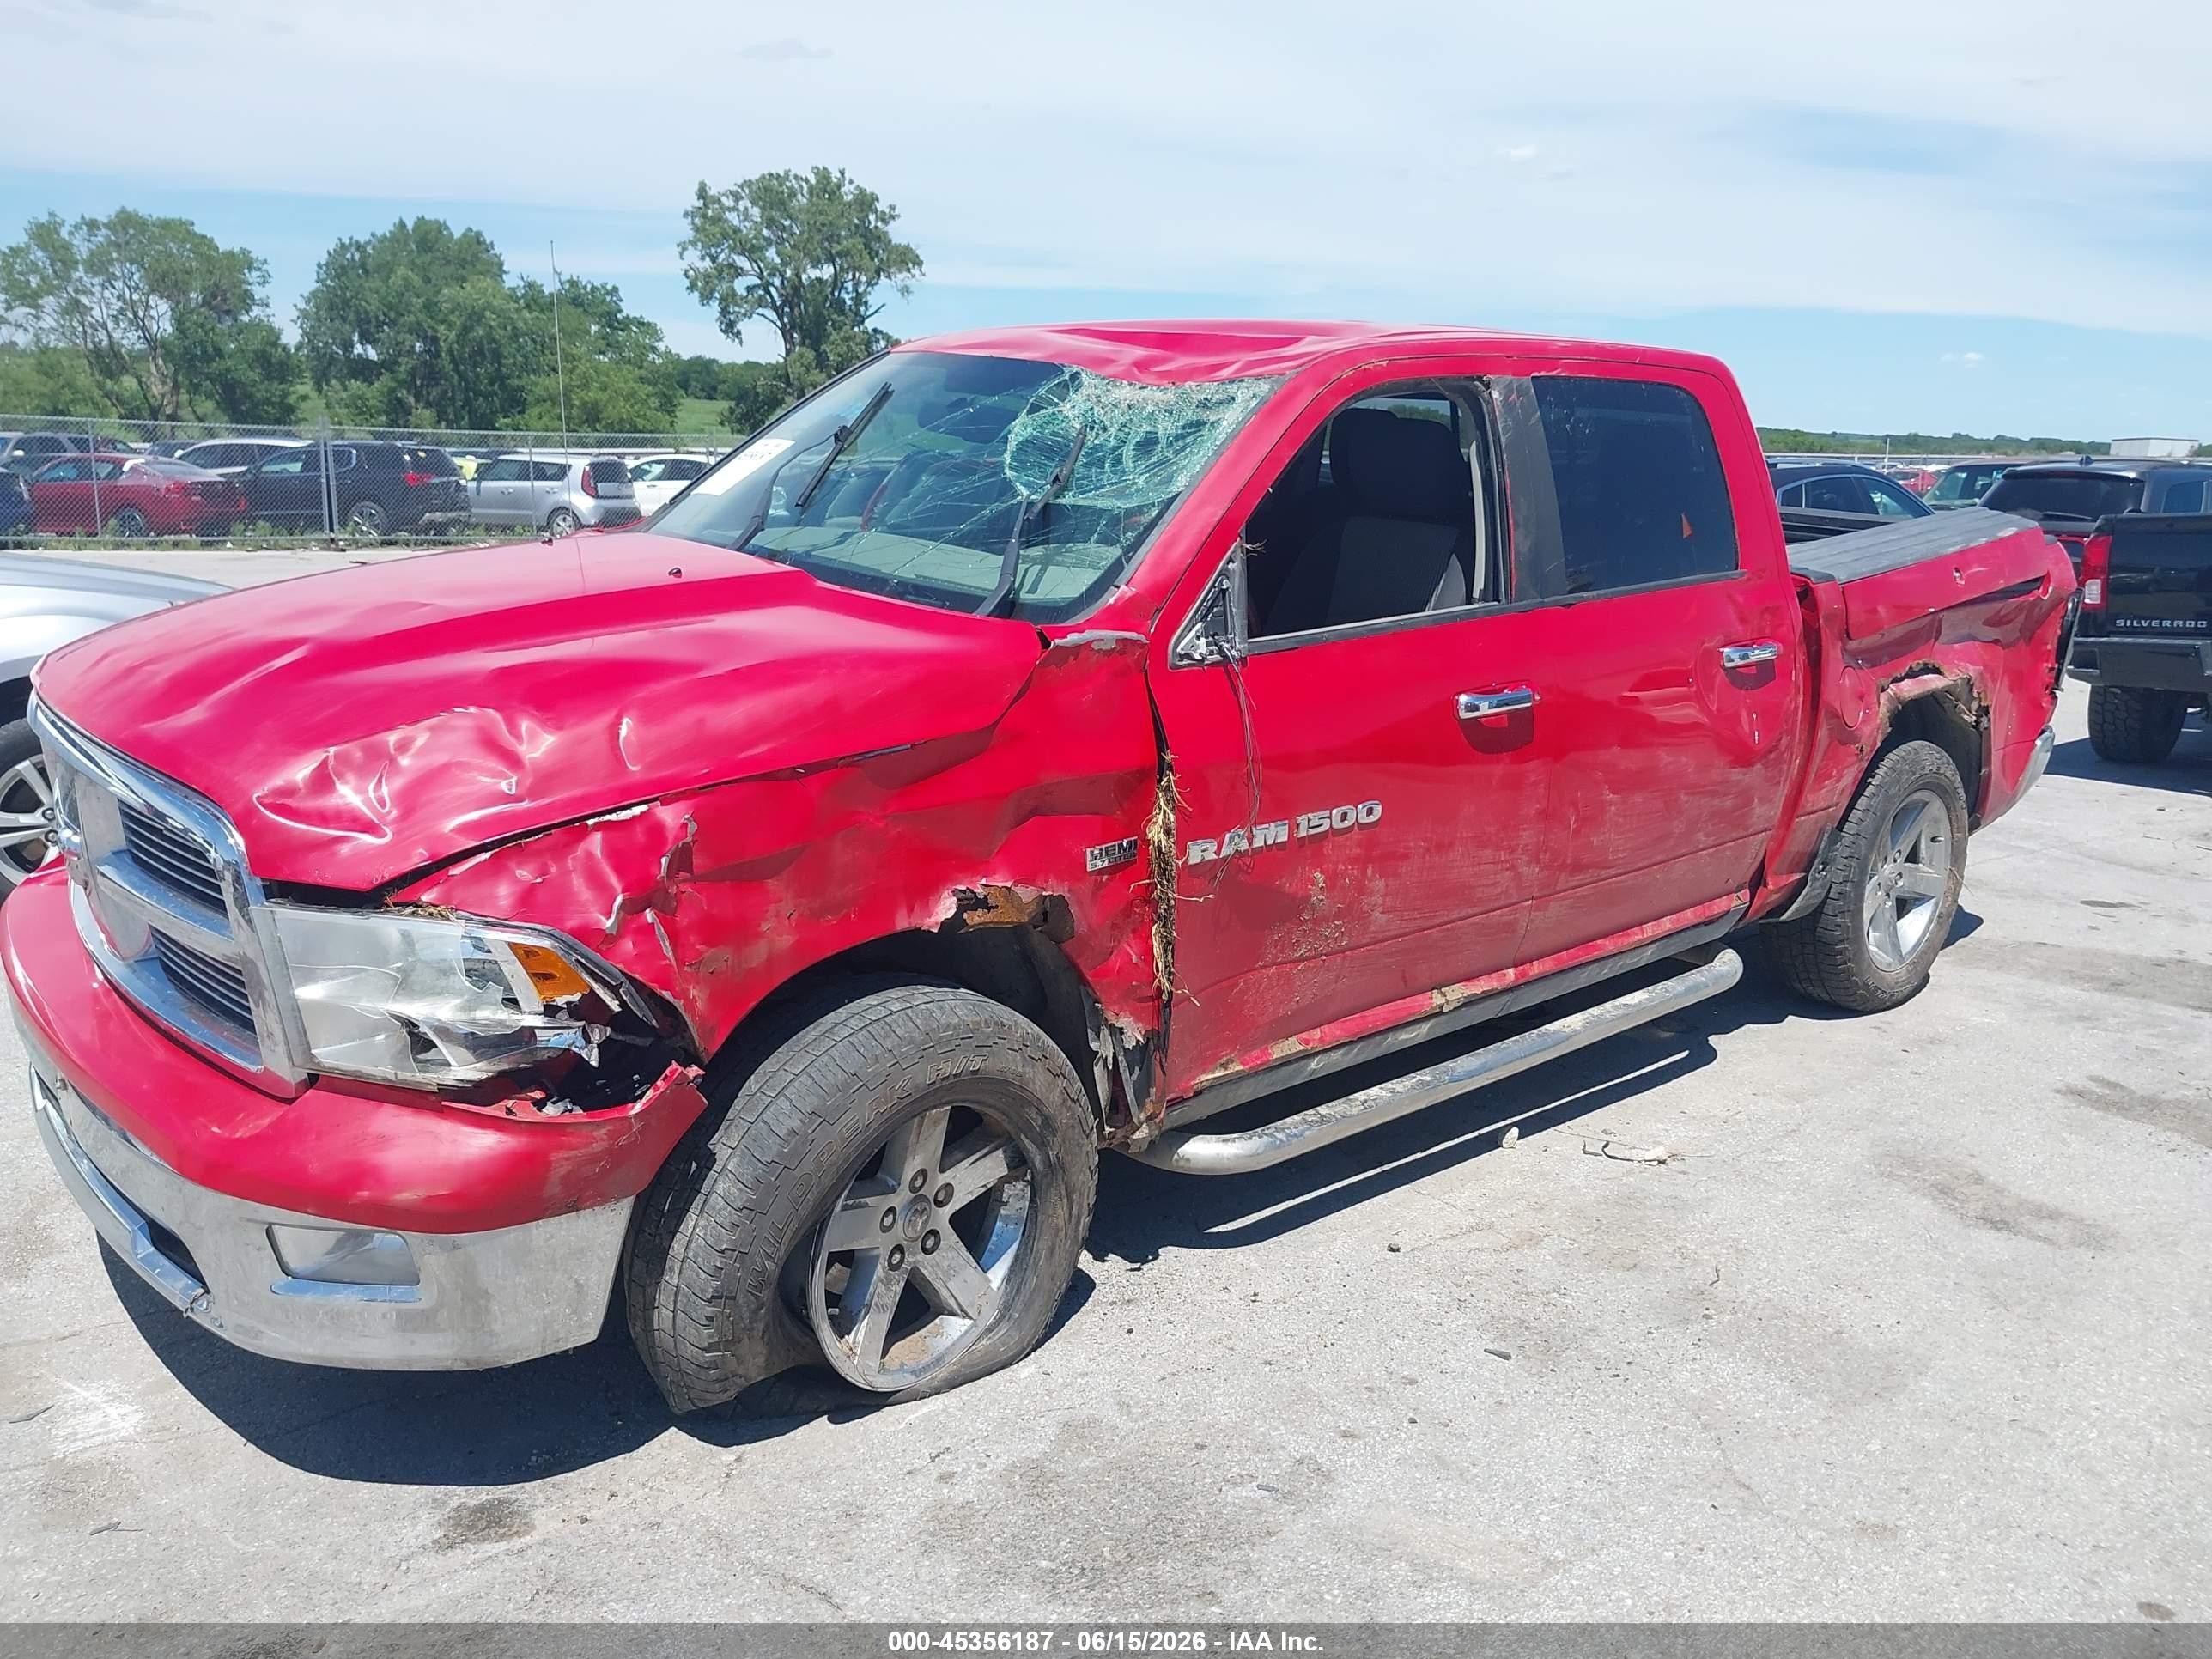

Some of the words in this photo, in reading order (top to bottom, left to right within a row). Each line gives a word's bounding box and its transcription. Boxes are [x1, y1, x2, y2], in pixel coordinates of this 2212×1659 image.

[2115, 619, 2208, 628] SILVERADO
[1188, 820, 1288, 866] RAM
[1295, 800, 1382, 838] 1500
[1089, 838, 1138, 861] HEMI
[1090, 860, 1107, 870] 5.7
[746, 1075, 913, 1299] WILDPEAK
[926, 1053, 988, 1085] H/T
